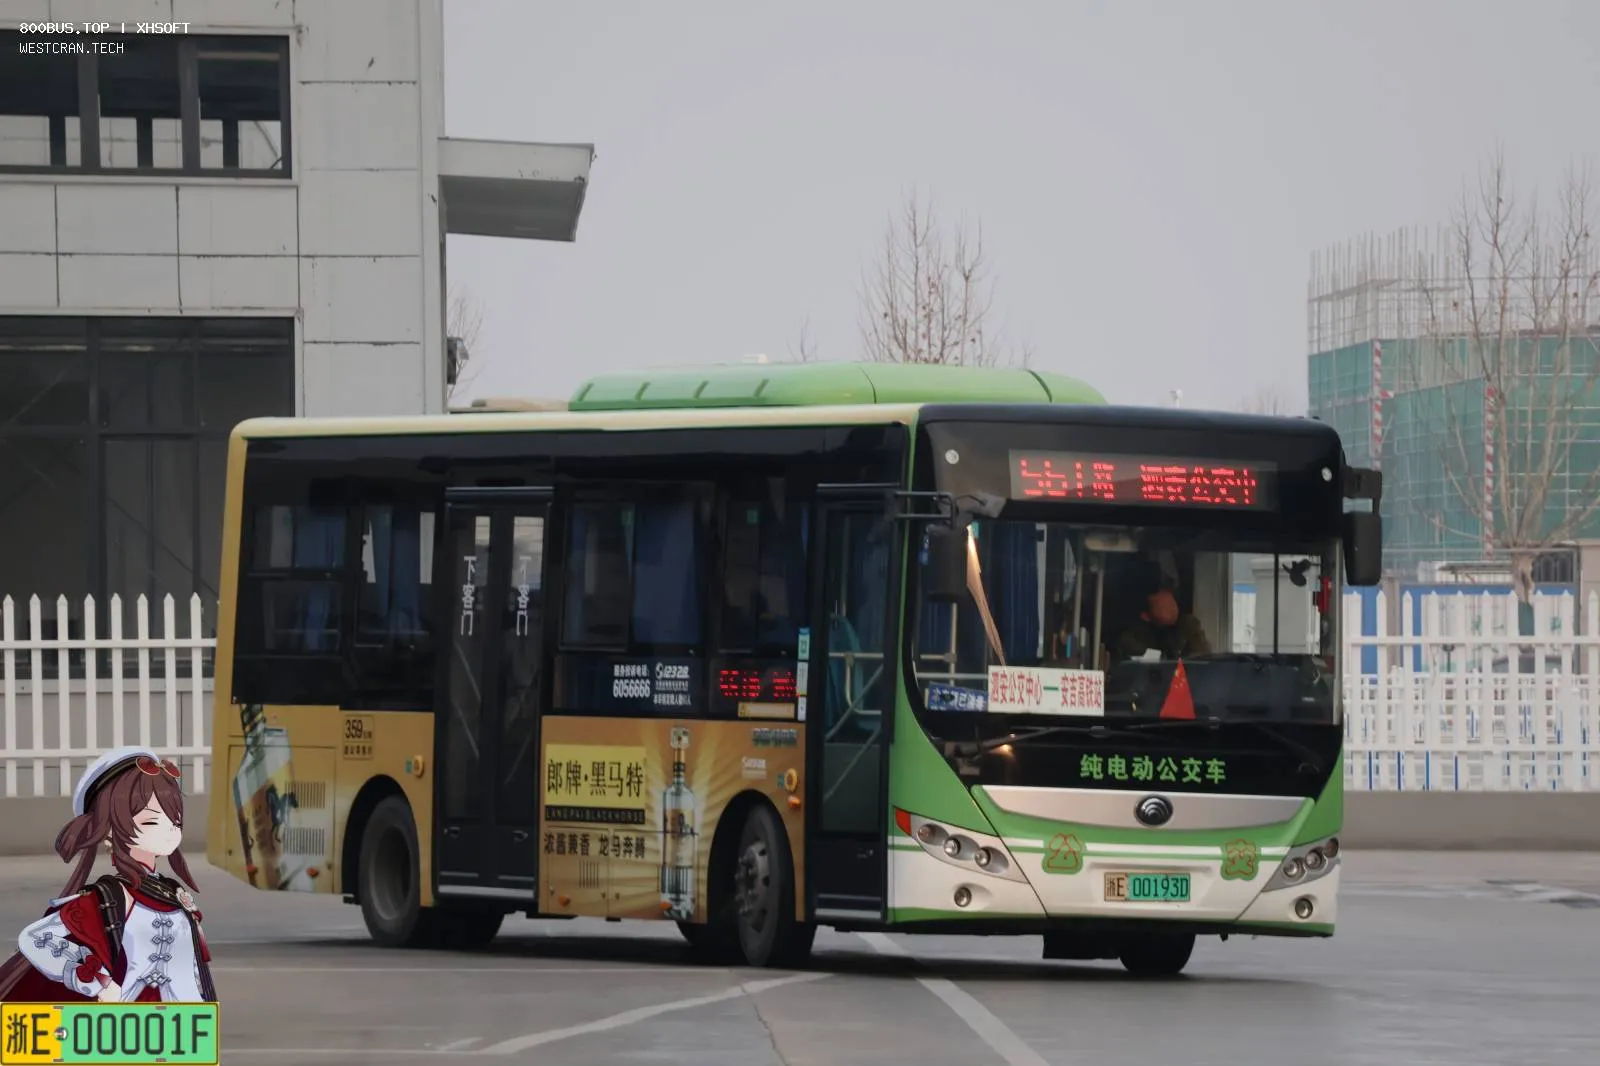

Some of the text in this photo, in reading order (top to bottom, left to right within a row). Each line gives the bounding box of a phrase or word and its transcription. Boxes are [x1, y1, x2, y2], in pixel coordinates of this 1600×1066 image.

[461, 555, 477, 636] 下客门
[613, 679, 651, 699] 6056666
[1080, 754, 1226, 784] 纯电动公交车
